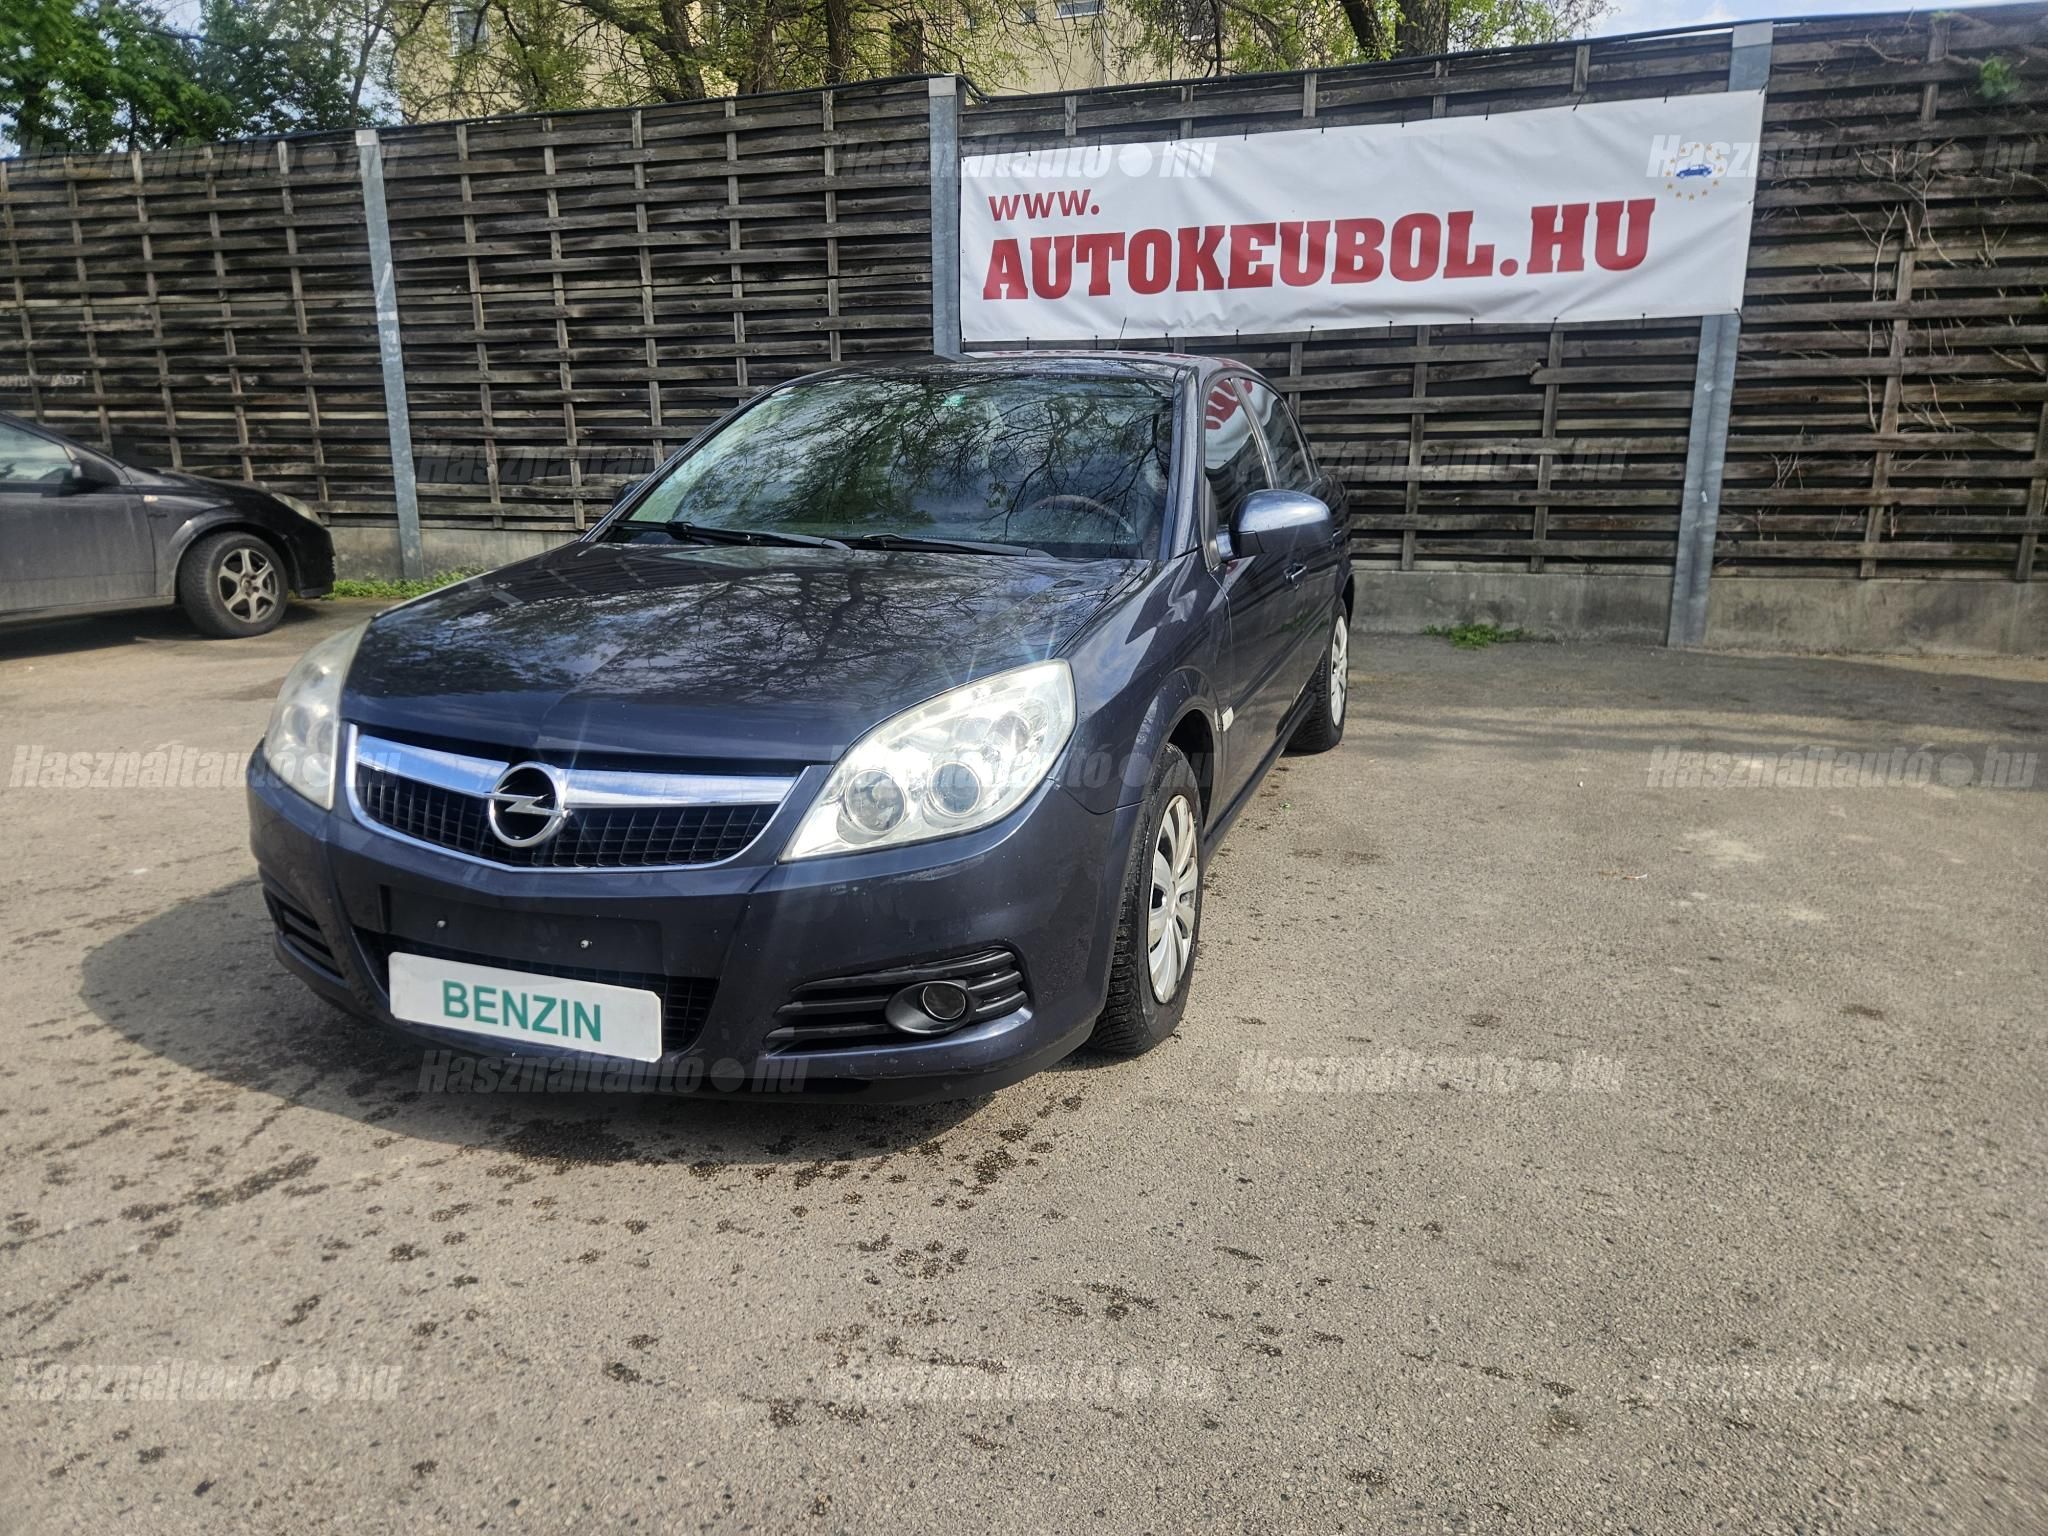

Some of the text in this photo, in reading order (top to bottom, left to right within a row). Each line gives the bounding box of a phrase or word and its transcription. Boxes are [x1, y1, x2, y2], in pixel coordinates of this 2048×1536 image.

[988, 189, 1100, 221] www.
[982, 198, 1656, 300] AUTOKEUBOL.HU
[441, 980, 602, 1043] BENZIN
